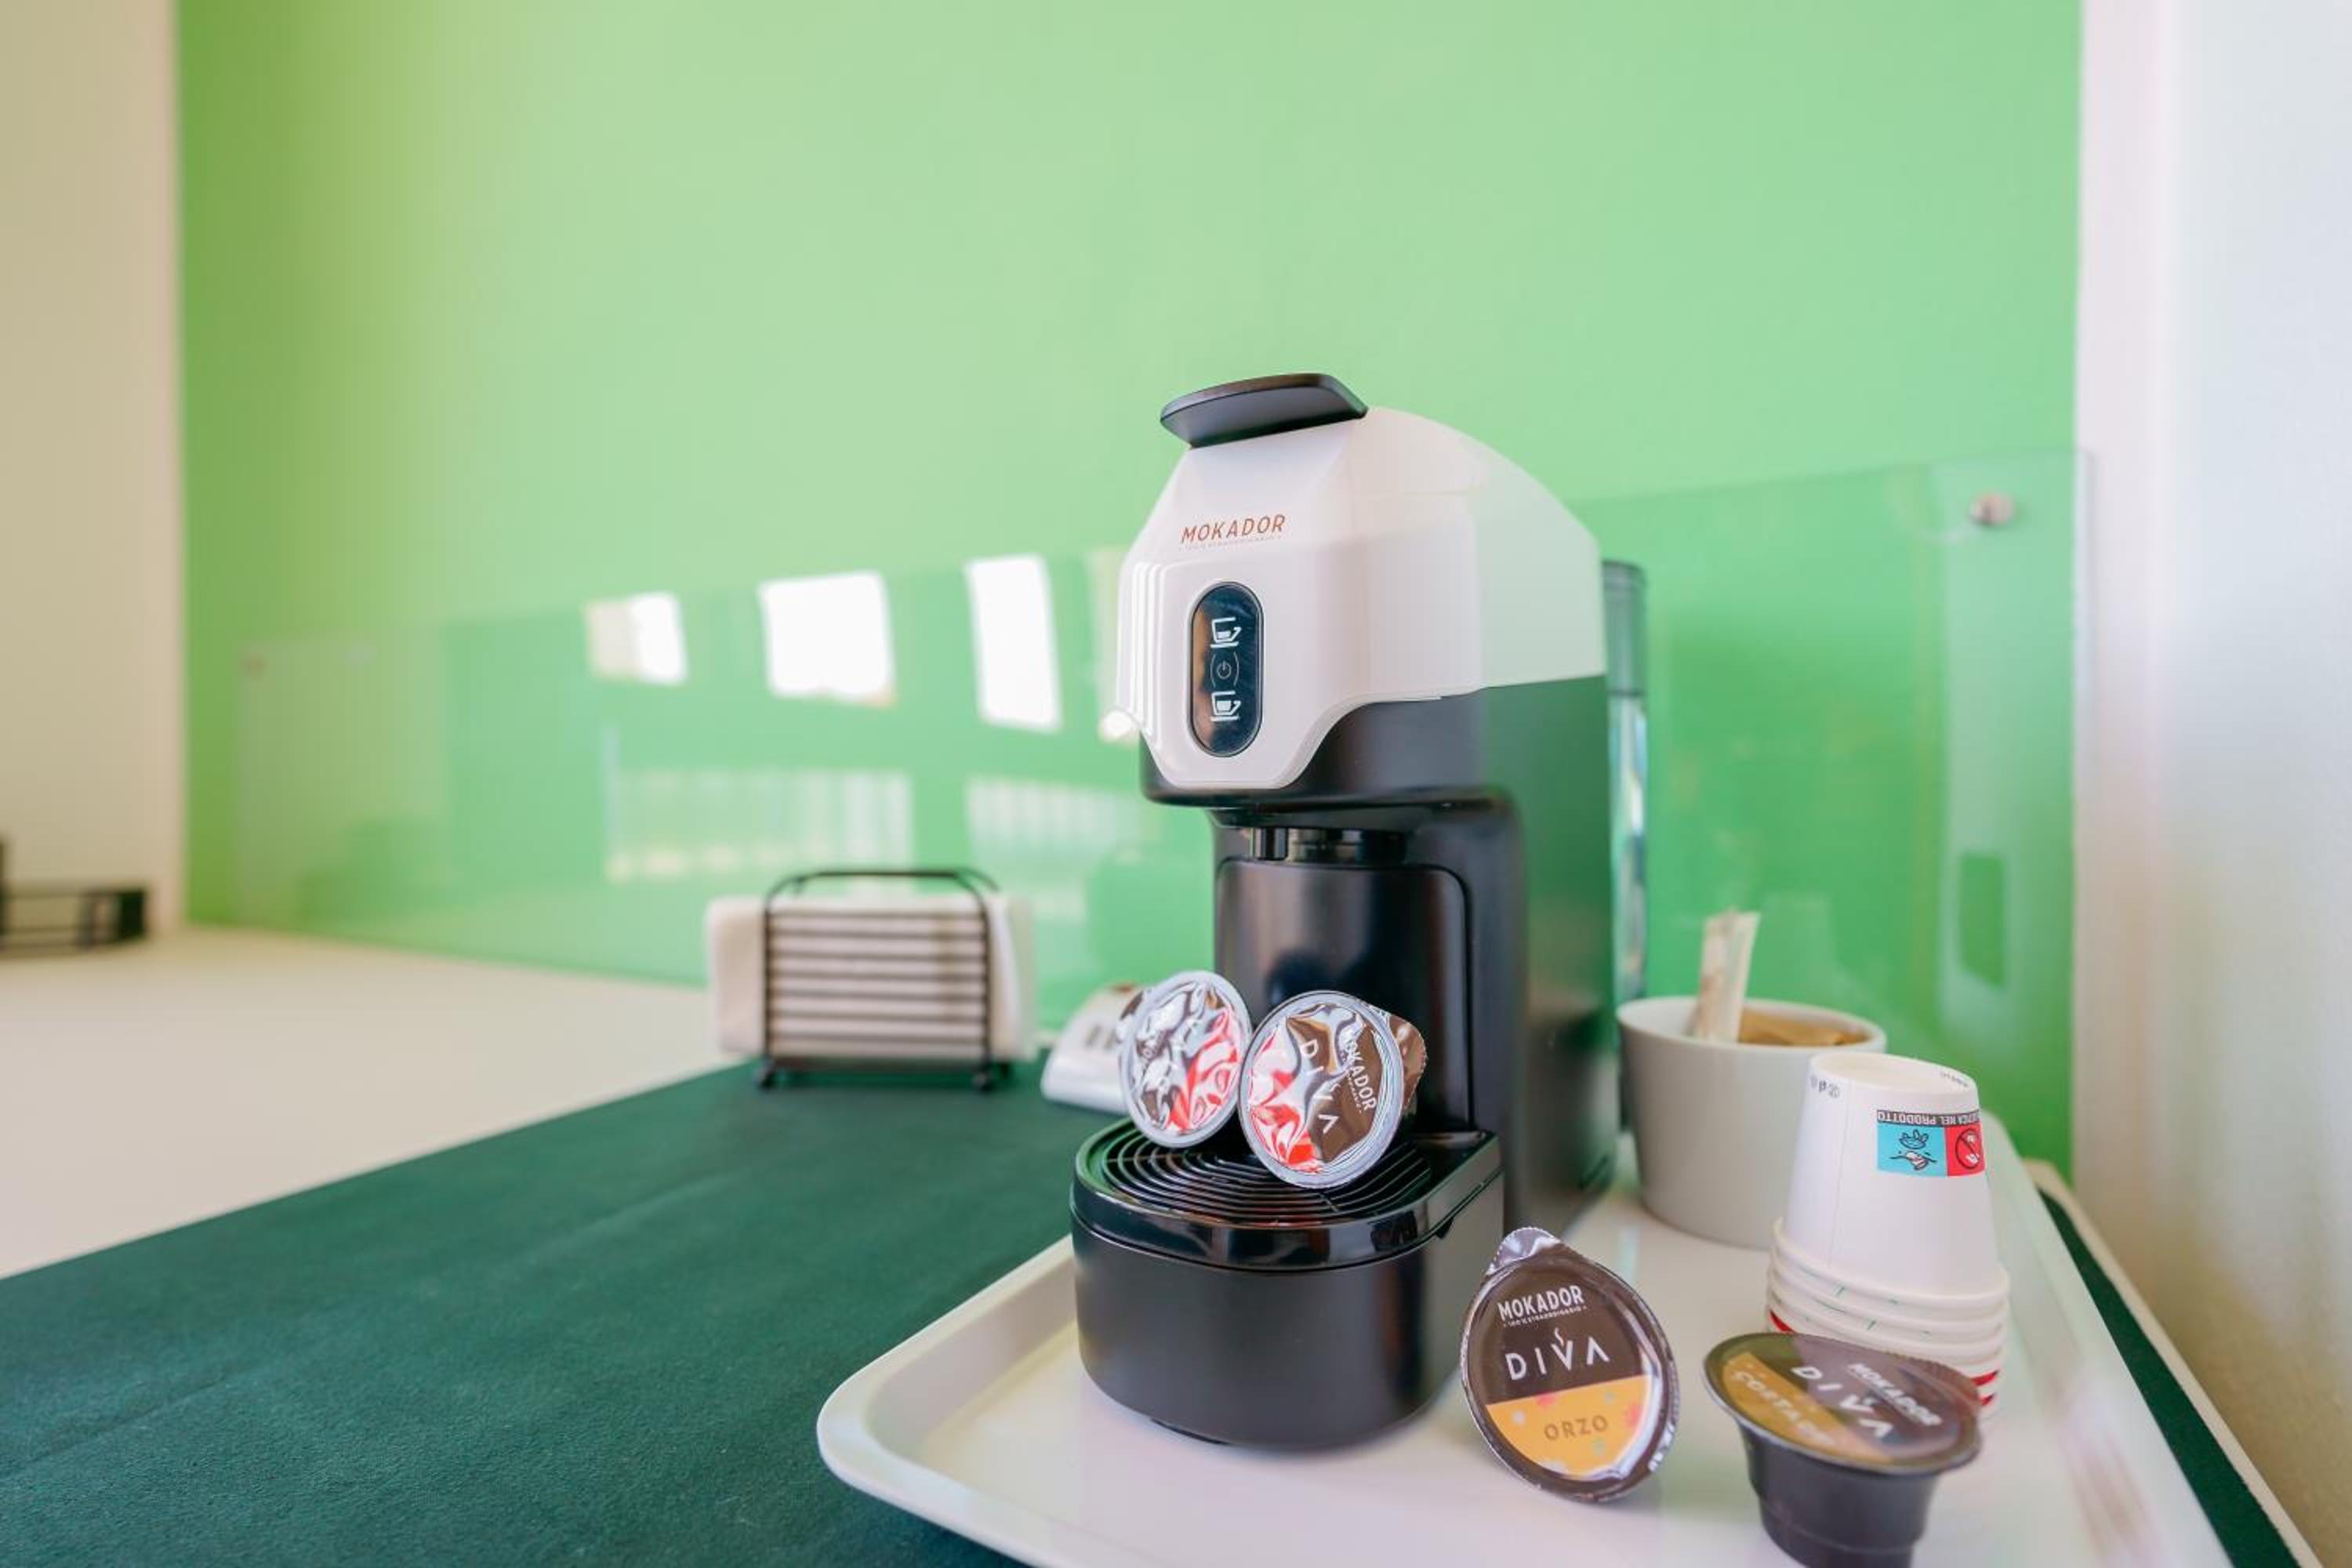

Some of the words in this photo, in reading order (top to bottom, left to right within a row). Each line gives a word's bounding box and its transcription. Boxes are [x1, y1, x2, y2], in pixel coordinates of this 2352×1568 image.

[1181, 514, 1286, 543] MOKADOR
[1877, 1110, 1936, 1126] PRODOTTO
[1940, 1115, 1956, 1126] NEL
[1497, 1284, 1585, 1323] MOKADOR
[1505, 1336, 1610, 1381] DIVA
[1790, 1366, 1894, 1438] DIVA
[1544, 1415, 1608, 1441] ORZO
